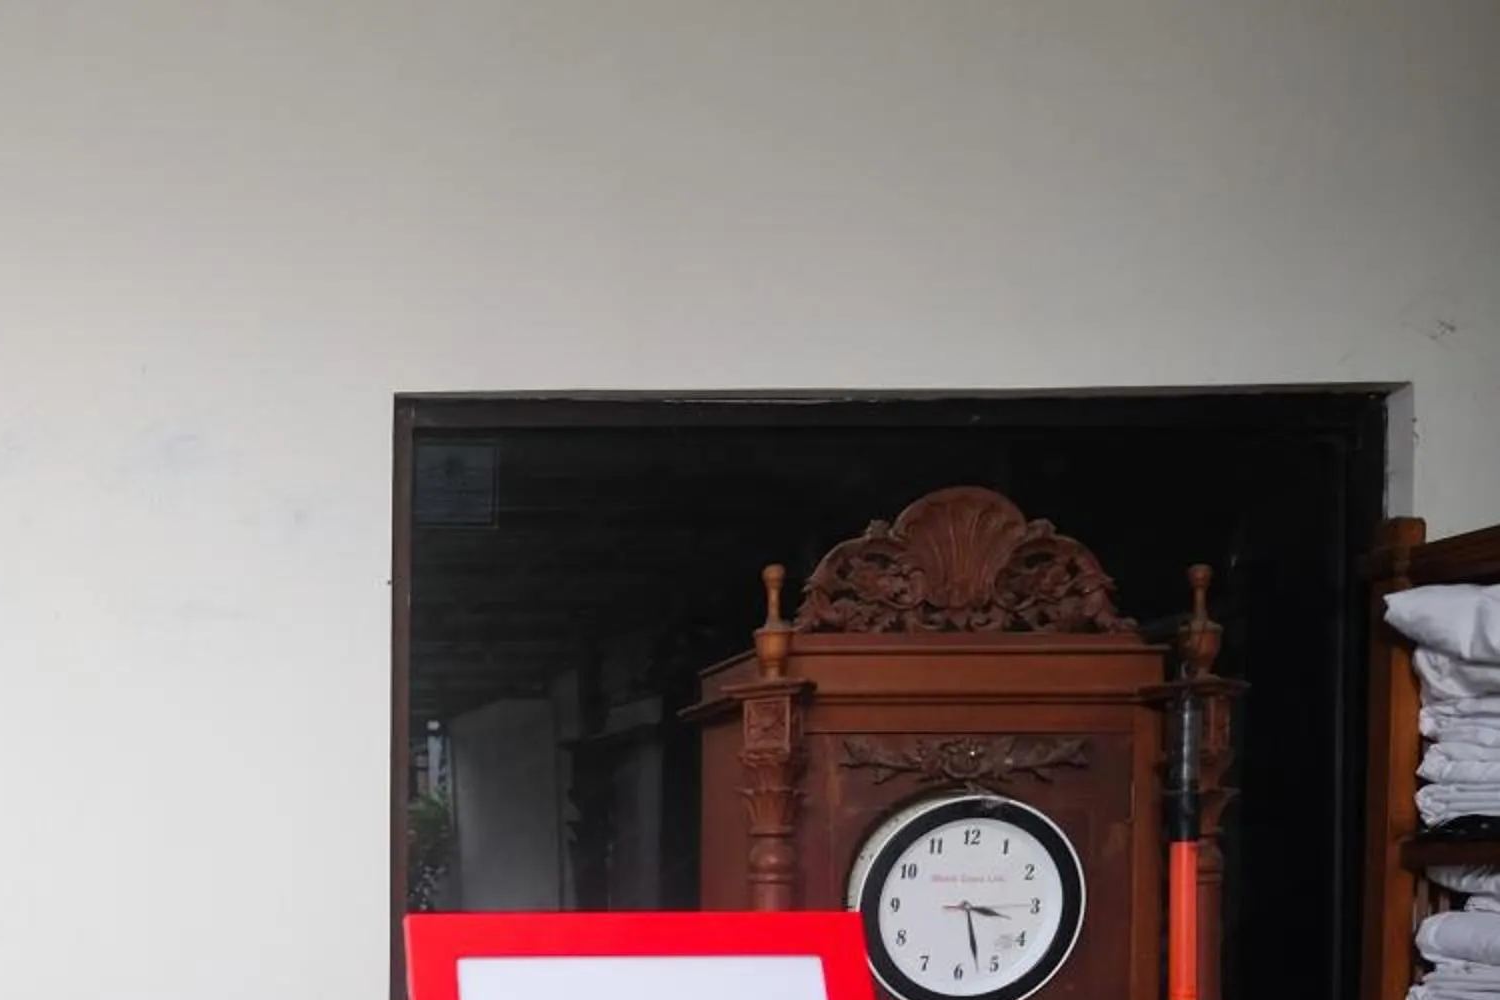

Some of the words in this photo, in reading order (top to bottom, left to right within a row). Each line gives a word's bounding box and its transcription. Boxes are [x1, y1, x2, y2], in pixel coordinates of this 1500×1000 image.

[963, 829, 981, 846] 12
[929, 838, 944, 855] 11
[1002, 838, 1010, 855] 1
[900, 863, 918, 880] 10
[1024, 864, 1036, 881] 2
[889, 897, 901, 914] 9
[1030, 898, 1041, 915] 3
[895, 929, 907, 946] 8
[1015, 931, 1026, 948] 4
[919, 955, 930, 972] 7
[953, 963, 964, 981] 6
[989, 957, 1000, 973] 5
